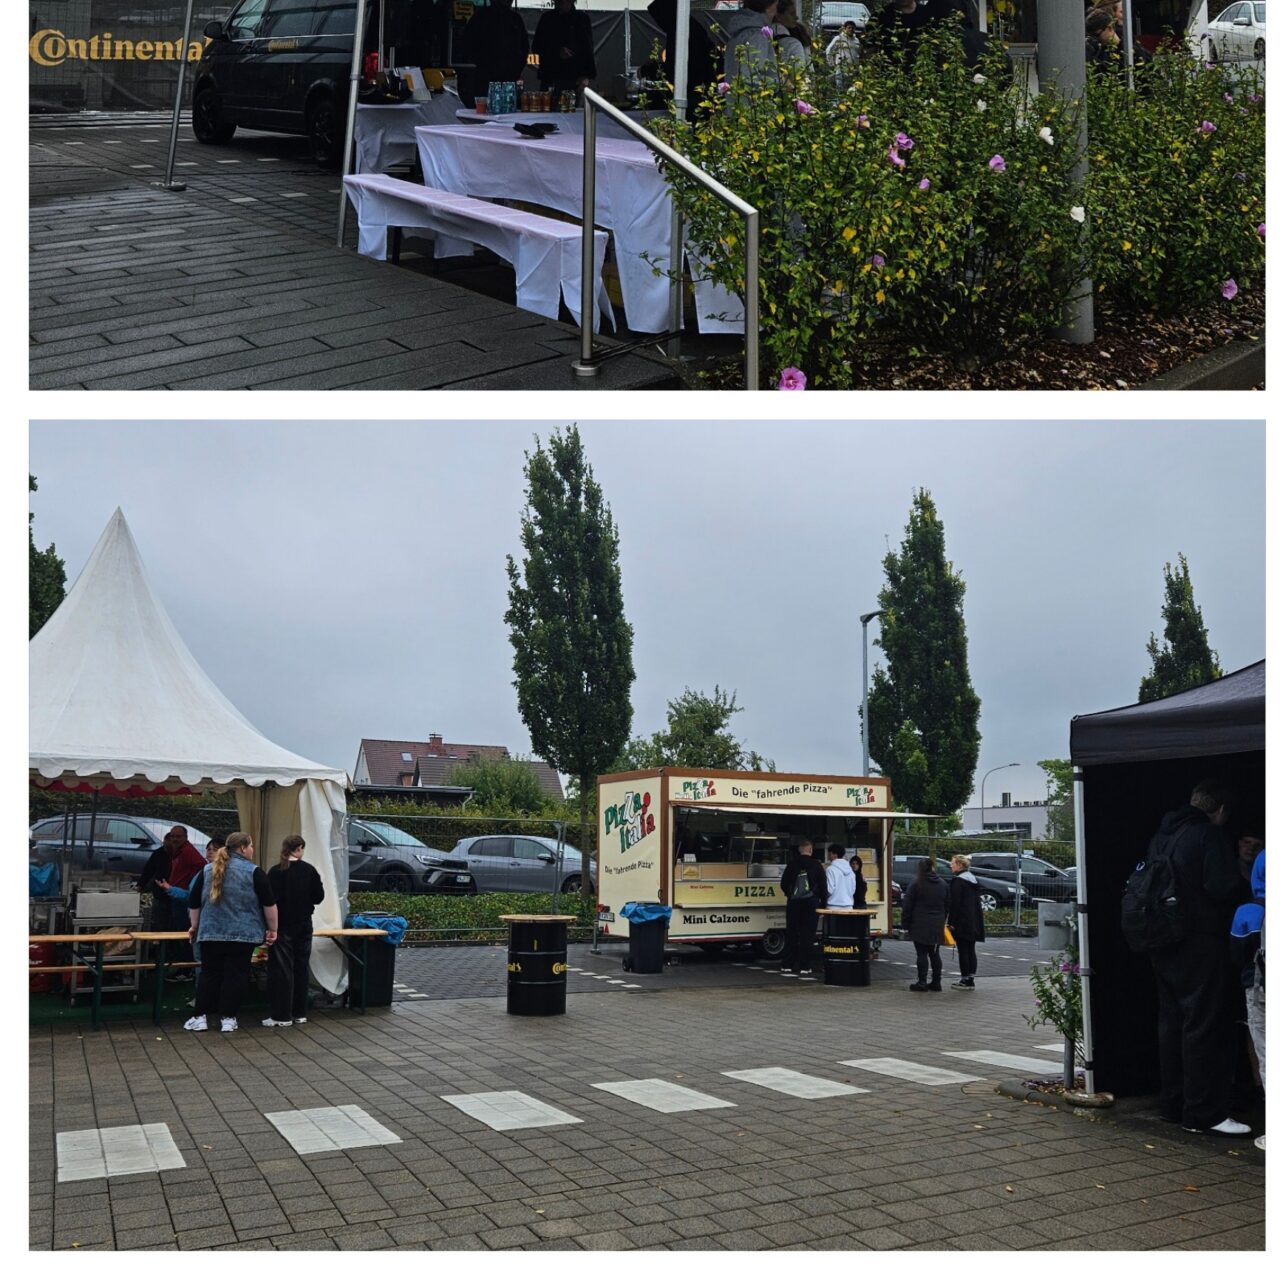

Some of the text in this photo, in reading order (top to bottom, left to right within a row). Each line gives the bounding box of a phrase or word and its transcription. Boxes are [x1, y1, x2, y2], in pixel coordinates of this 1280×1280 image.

[30, 29, 212, 66] Continenta
[732, 787, 749, 798] Die
[734, 886, 776, 897] PIZZA
[683, 914, 750, 924] Mini Calzone
